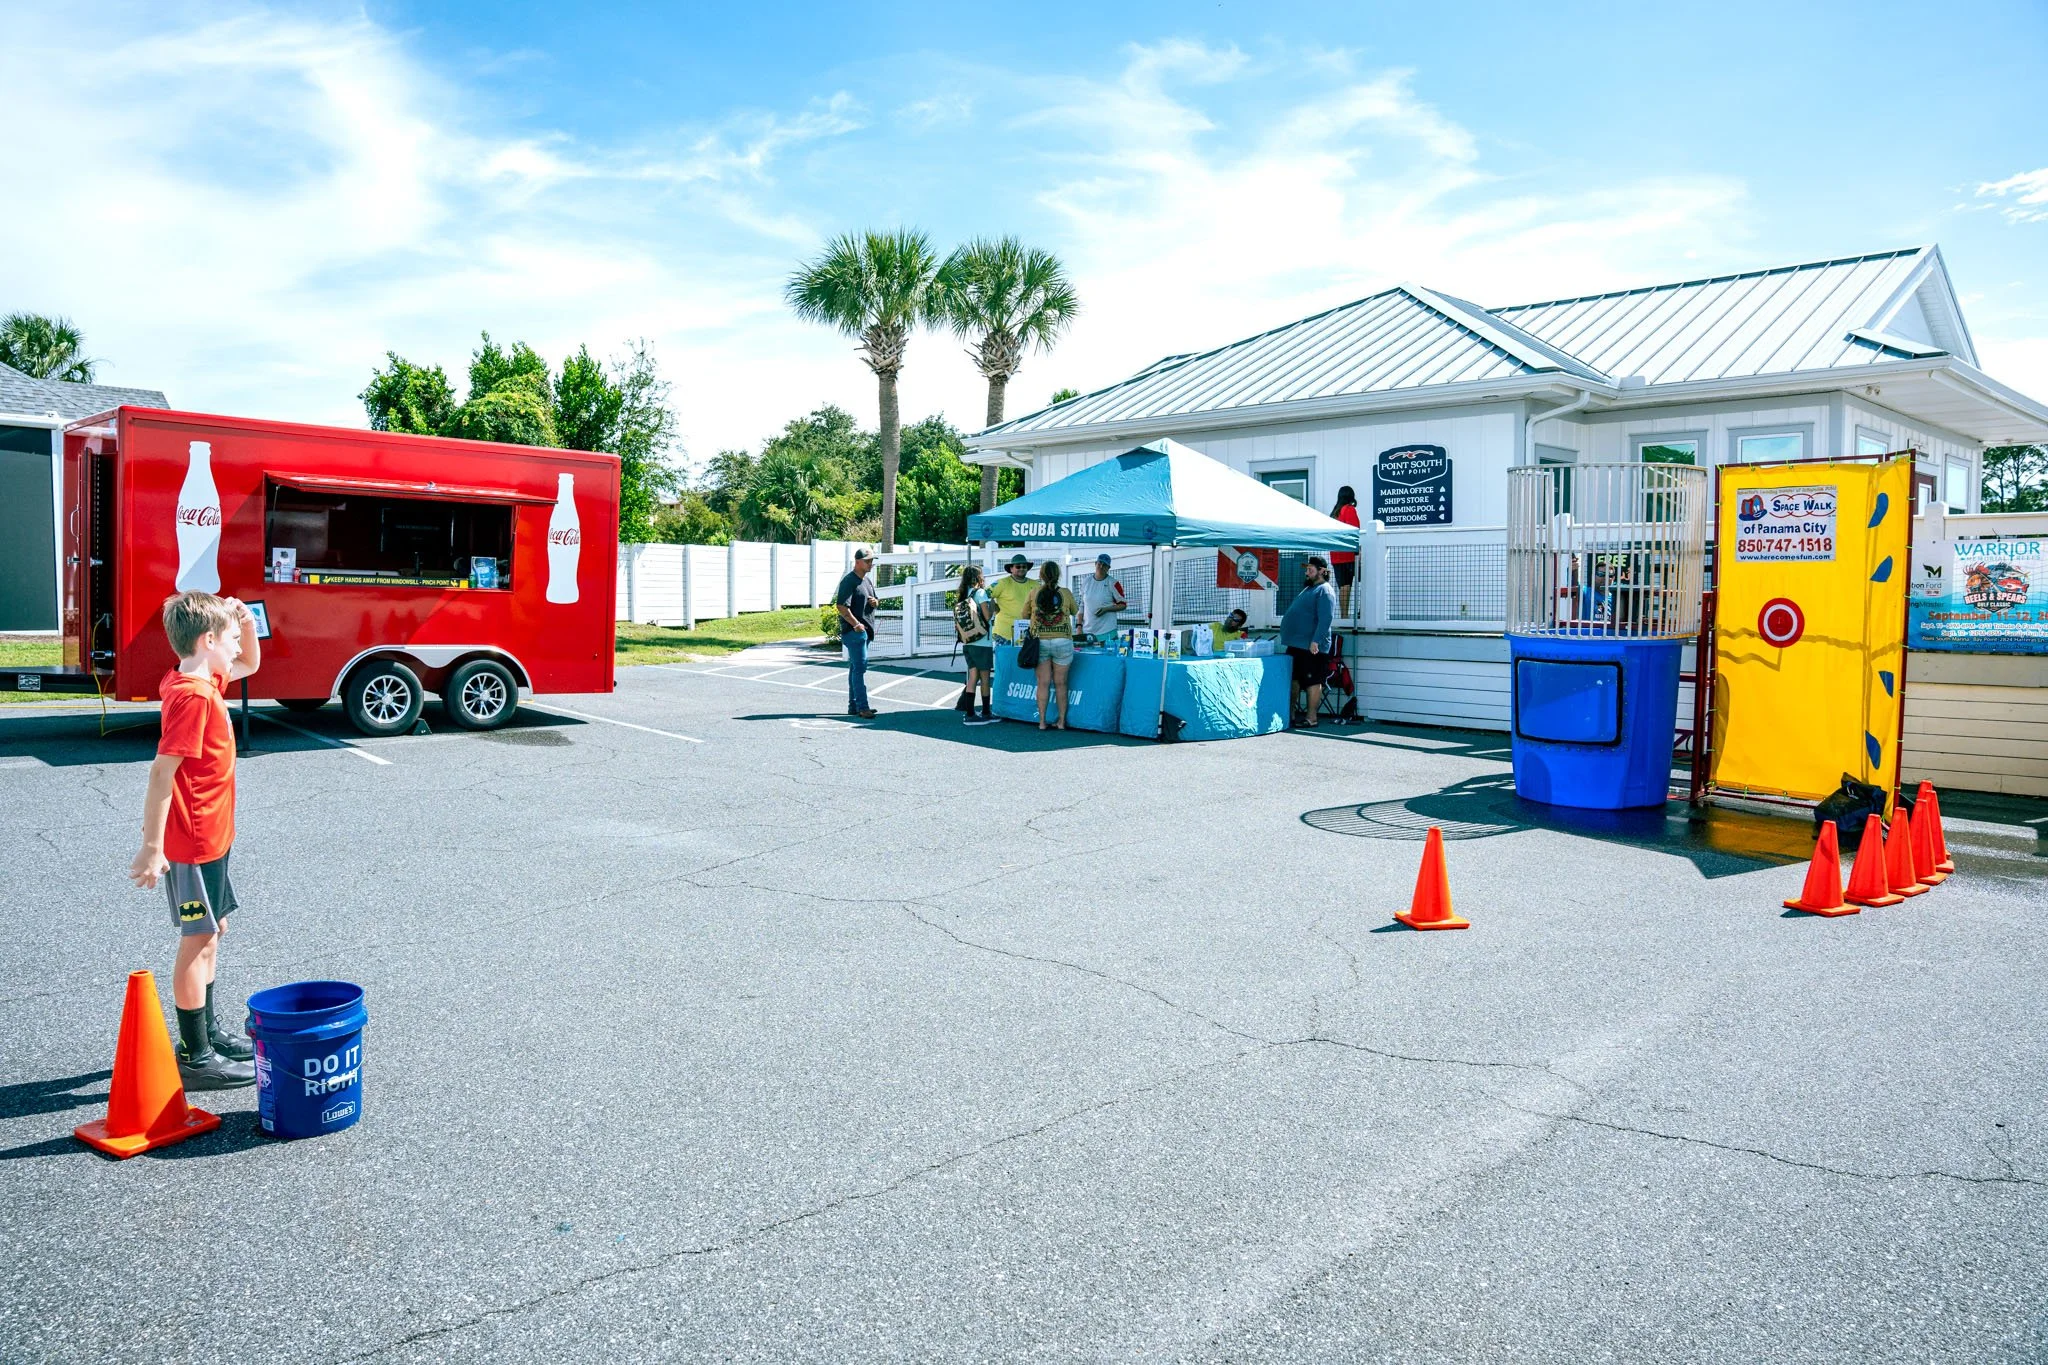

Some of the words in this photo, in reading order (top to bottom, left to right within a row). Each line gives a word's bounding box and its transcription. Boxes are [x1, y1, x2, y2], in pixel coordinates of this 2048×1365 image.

[1381, 462, 1409, 471] POINT
[1410, 459, 1443, 468] SOUTH
[1380, 488, 1409, 496] MARINA
[1409, 486, 1434, 494] OFFICE
[1384, 497, 1406, 505] SHIP'S
[1377, 506, 1416, 514] SWIMMING
[1416, 504, 1436, 512] POOL
[1386, 514, 1428, 523] RESTROOMS
[1011, 522, 1056, 537] SCUBA
[1060, 522, 1120, 538] STATION
[1744, 523, 1755, 535] of
[1757, 523, 1801, 534] Panama
[1803, 522, 1827, 535] City
[1737, 537, 1833, 553] 850-747-1518
[1954, 541, 2041, 561] WARRIOR
[1926, 581, 1942, 589] Ford
[1929, 610, 1991, 621] September
[1007, 682, 1038, 701] SCUBA
[304, 1054, 339, 1077] DO
[345, 1045, 360, 1068] IT
